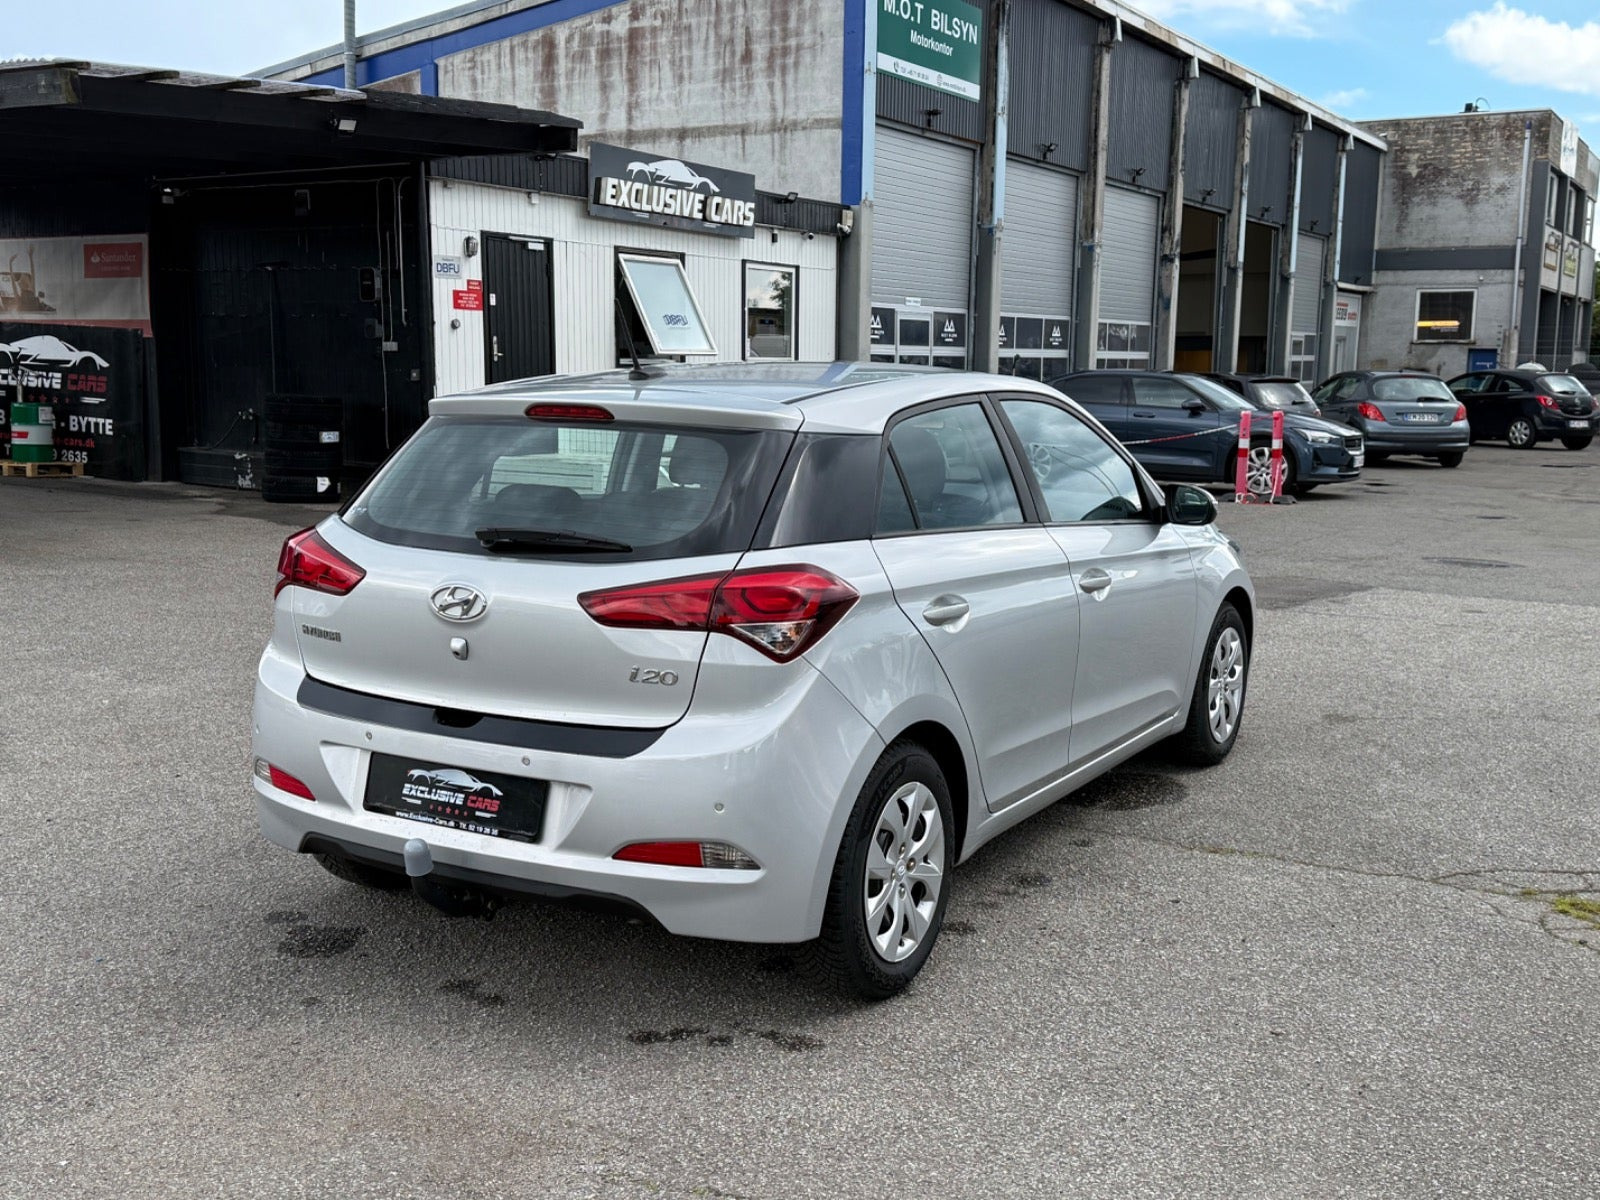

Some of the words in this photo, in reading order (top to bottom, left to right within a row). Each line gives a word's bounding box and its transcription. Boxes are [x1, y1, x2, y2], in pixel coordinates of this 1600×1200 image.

[883, 0, 924, 24] M.O.T
[930, 8, 978, 45] BILSYN
[910, 29, 953, 57] Motorkontor
[605, 177, 705, 220] EXCLUSIVE
[710, 195, 756, 227] CARS
[100, 251, 136, 263] Santander
[436, 262, 460, 274] DBFU
[67, 373, 108, 393] CARS
[69, 415, 114, 436] BYTTE
[61, 449, 88, 464] 2635
[629, 665, 679, 686] i20
[402, 783, 465, 806] EXCLUSIVE
[466, 795, 500, 812] CARS
